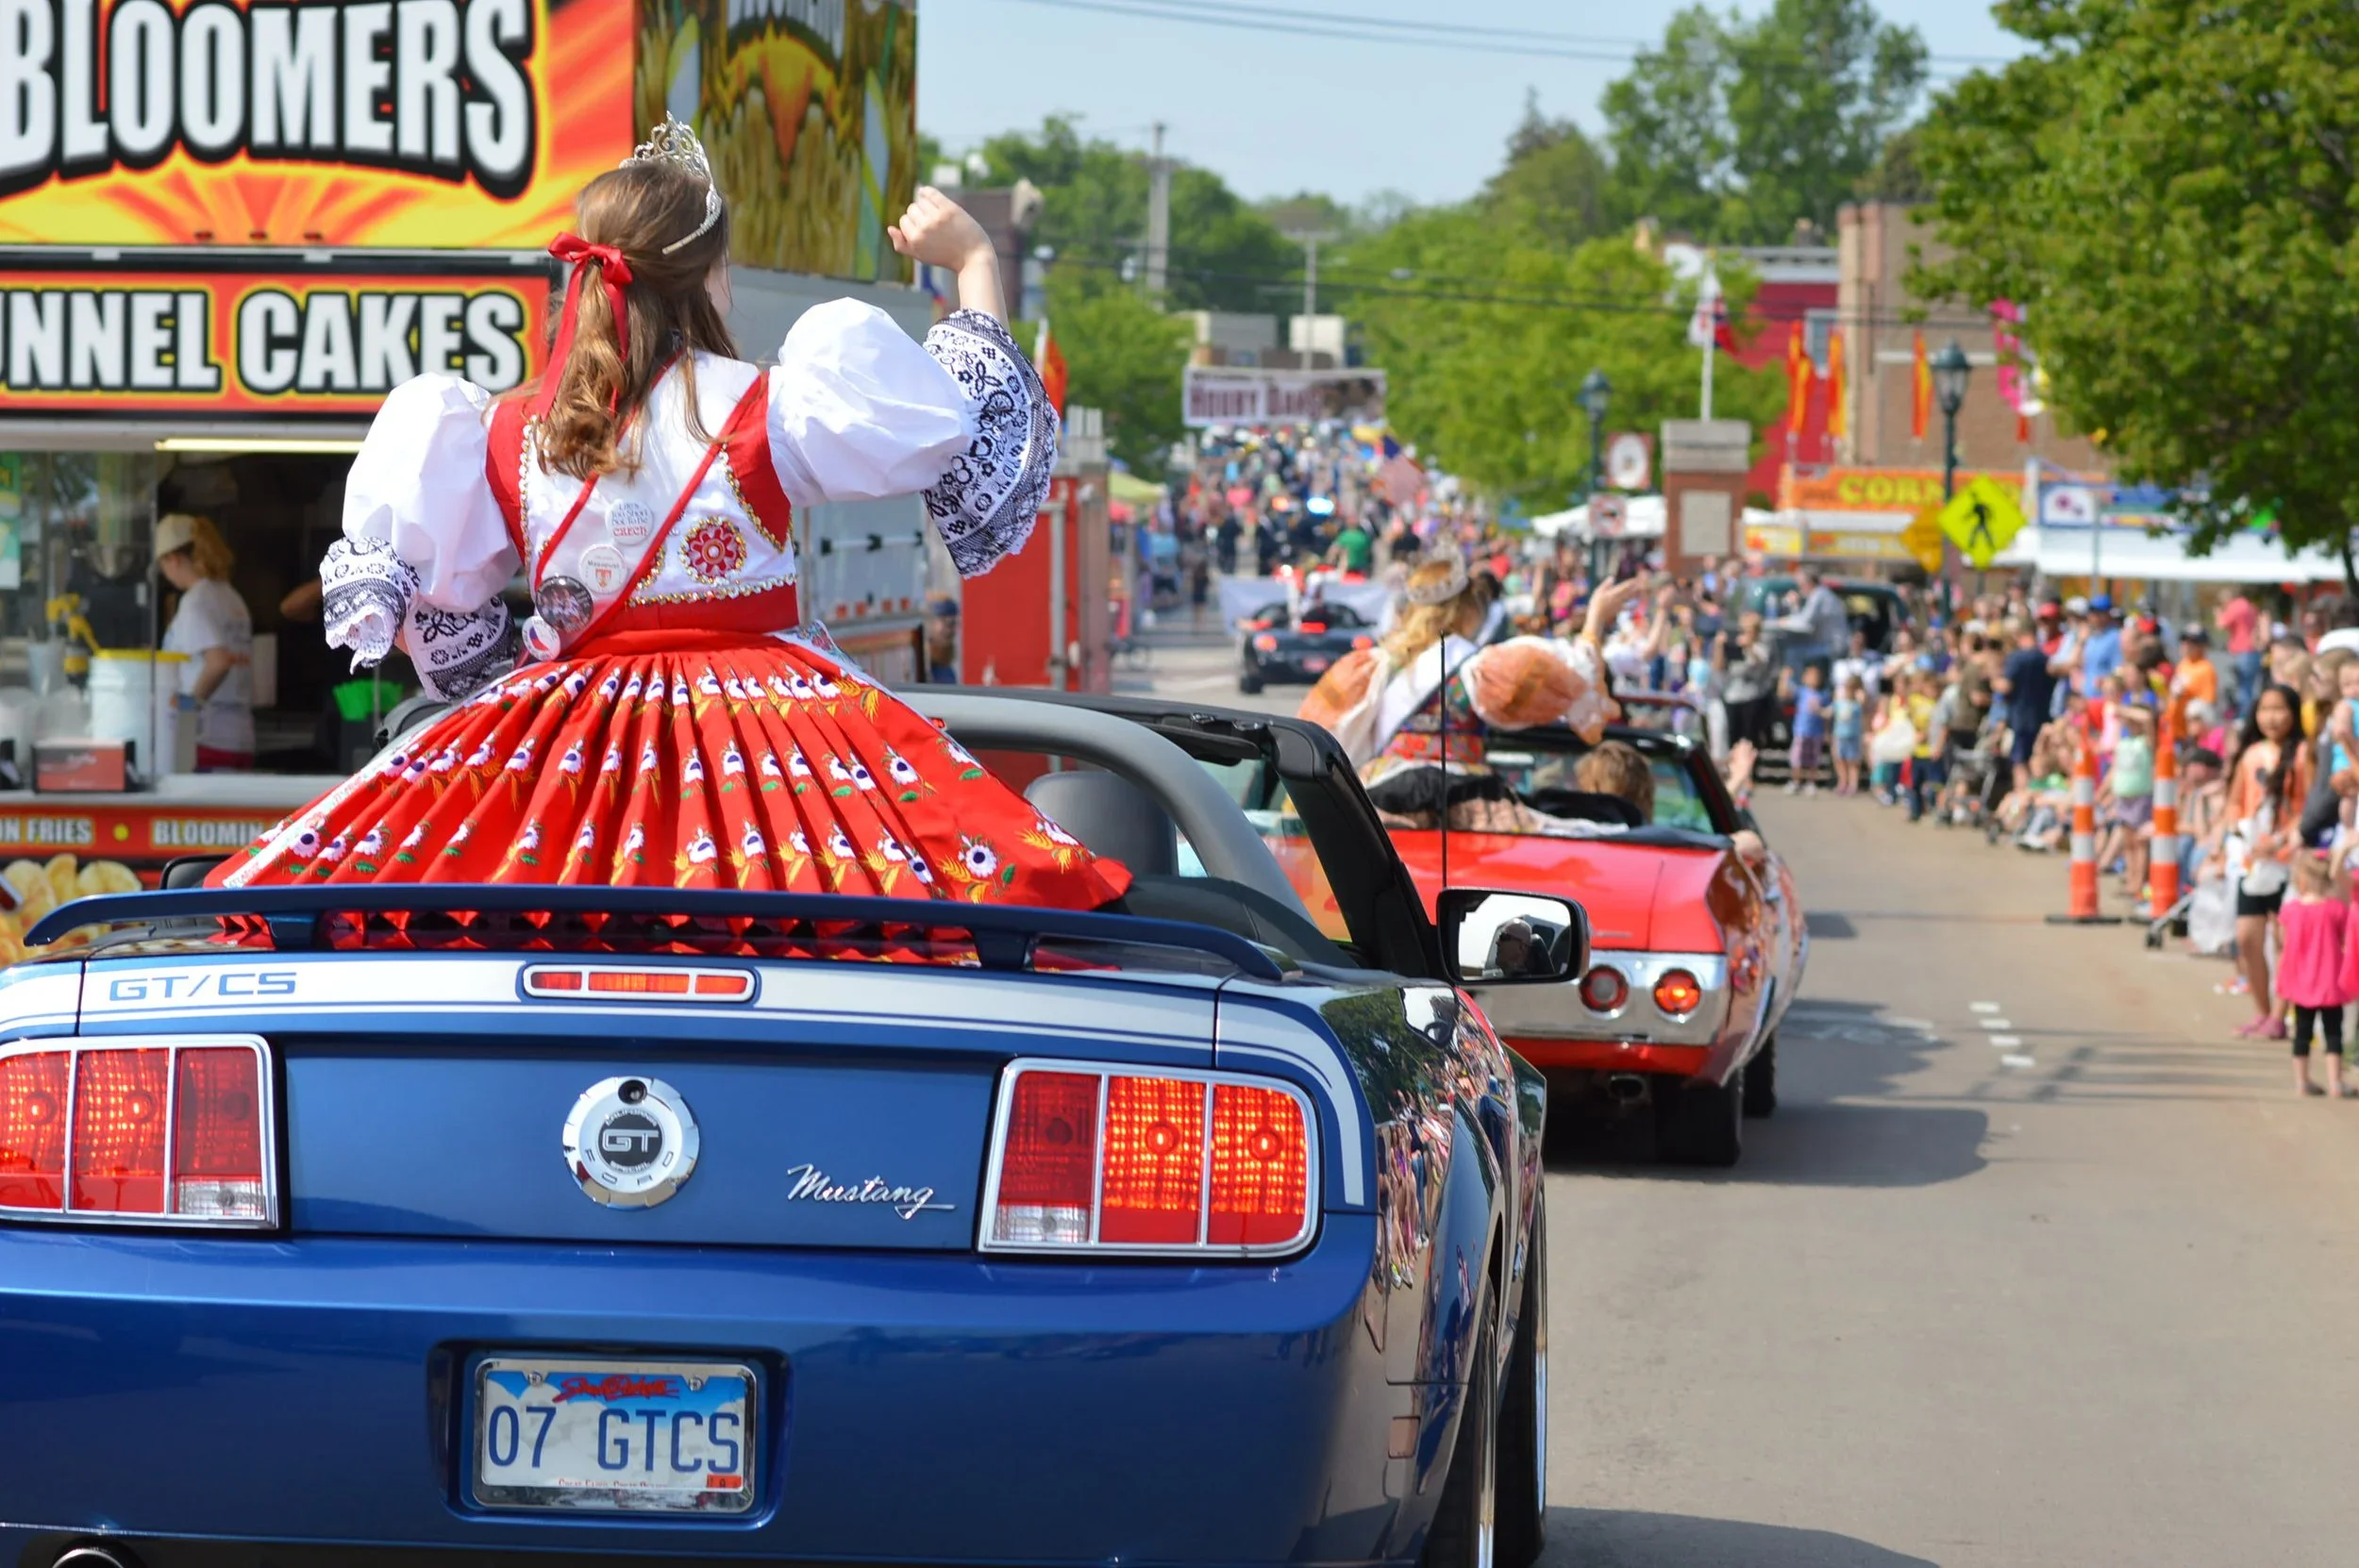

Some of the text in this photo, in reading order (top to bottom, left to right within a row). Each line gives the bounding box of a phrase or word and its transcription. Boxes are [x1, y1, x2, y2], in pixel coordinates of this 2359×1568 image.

[0, 0, 533, 176] BLOOMERS
[0, 291, 524, 392] NNEL CAKES
[26, 817, 92, 843] FRIES
[109, 972, 297, 1001] GT/CS
[602, 1128, 660, 1153] GT
[584, 1147, 675, 1186] FORD
[787, 1163, 956, 1220] Mustang
[488, 1405, 740, 1474] 07 GTCS
